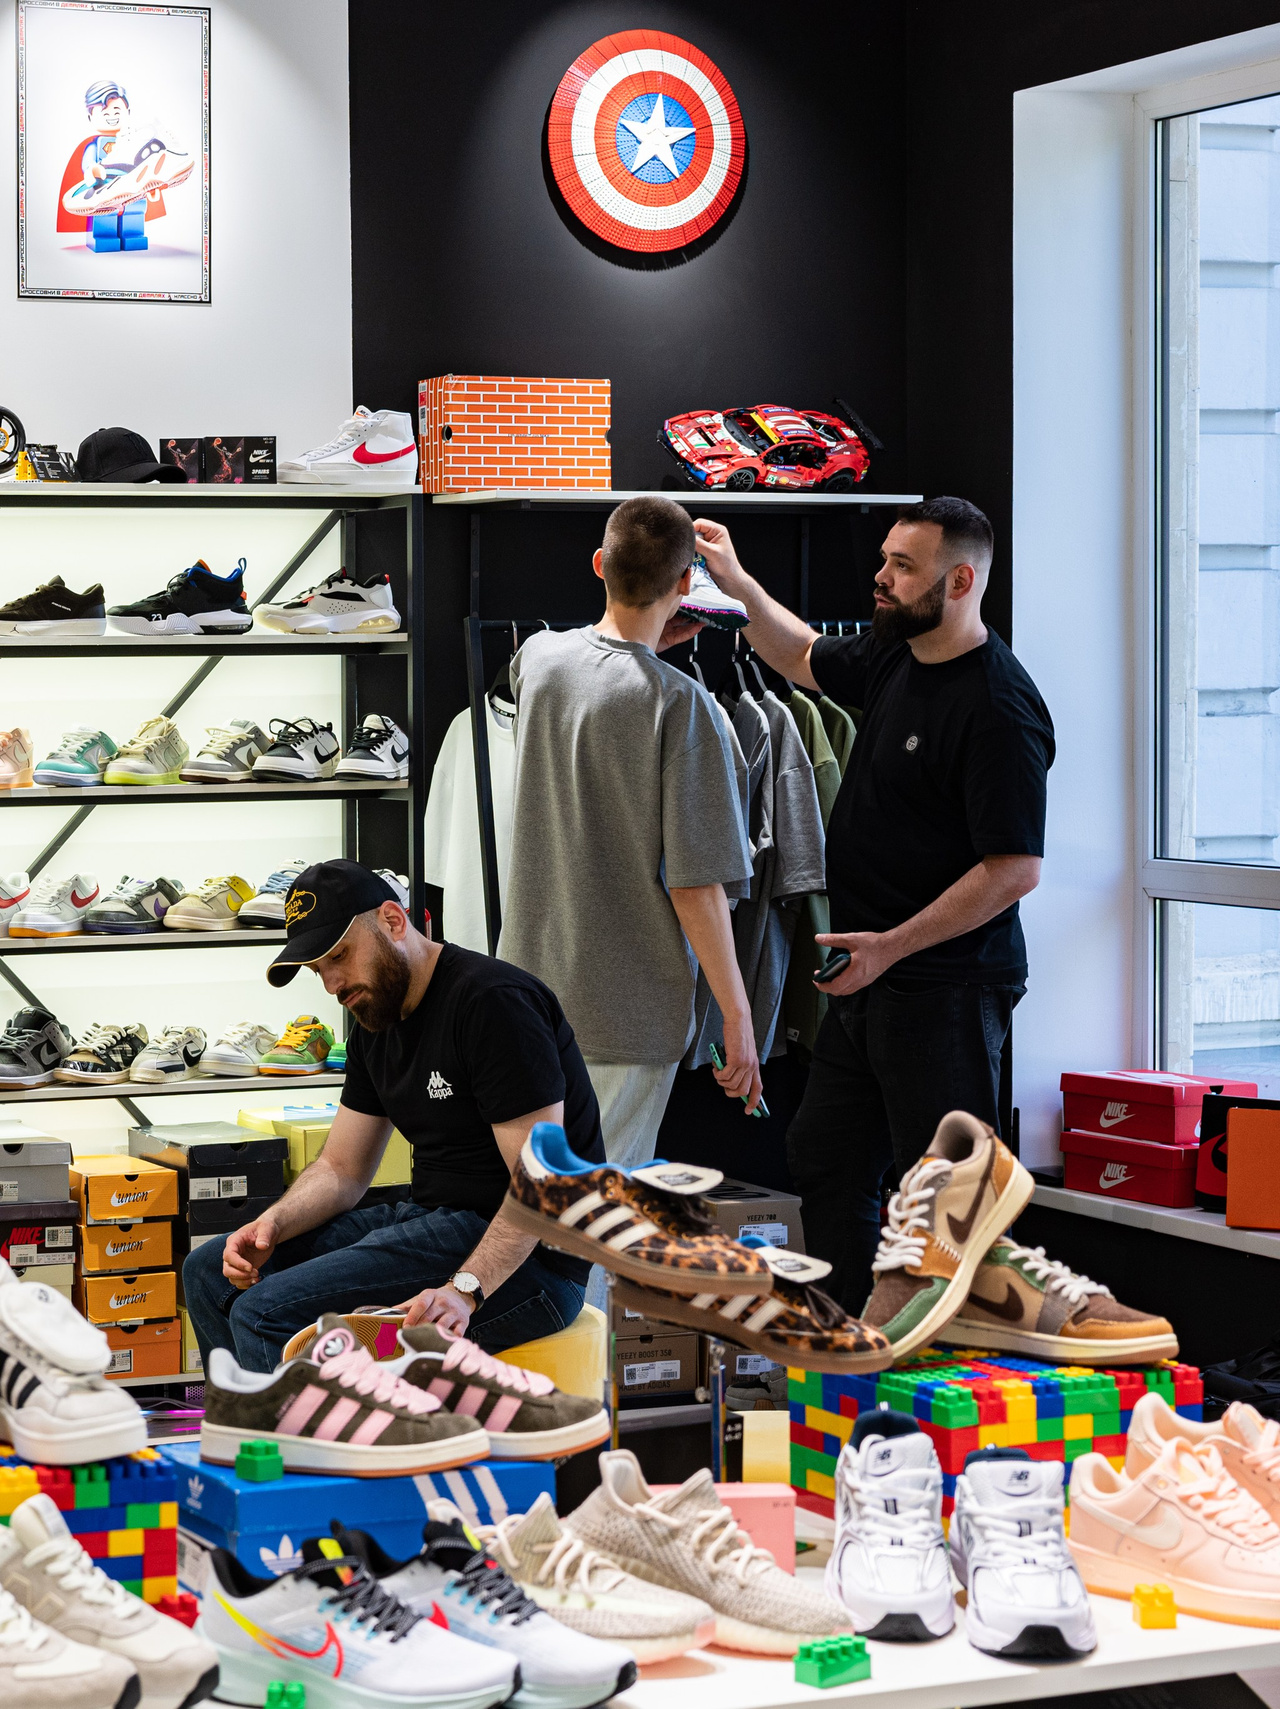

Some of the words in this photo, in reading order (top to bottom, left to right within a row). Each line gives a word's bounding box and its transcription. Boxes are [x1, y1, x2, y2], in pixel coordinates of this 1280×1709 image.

[151, 613, 163, 621] 23
[429, 1086, 454, 1101] Kappa
[1104, 1101, 1128, 1118] NIKE
[1104, 1162, 1128, 1179] NIKE
[117, 1186, 148, 1204] union
[8, 1226, 44, 1245] NIKE
[112, 1236, 143, 1254] union
[116, 1288, 147, 1306] union
[616, 1352, 637, 1360] YEEZY
[638, 1350, 659, 1358] BOOST
[648, 1382, 671, 1390] ADIDAS
